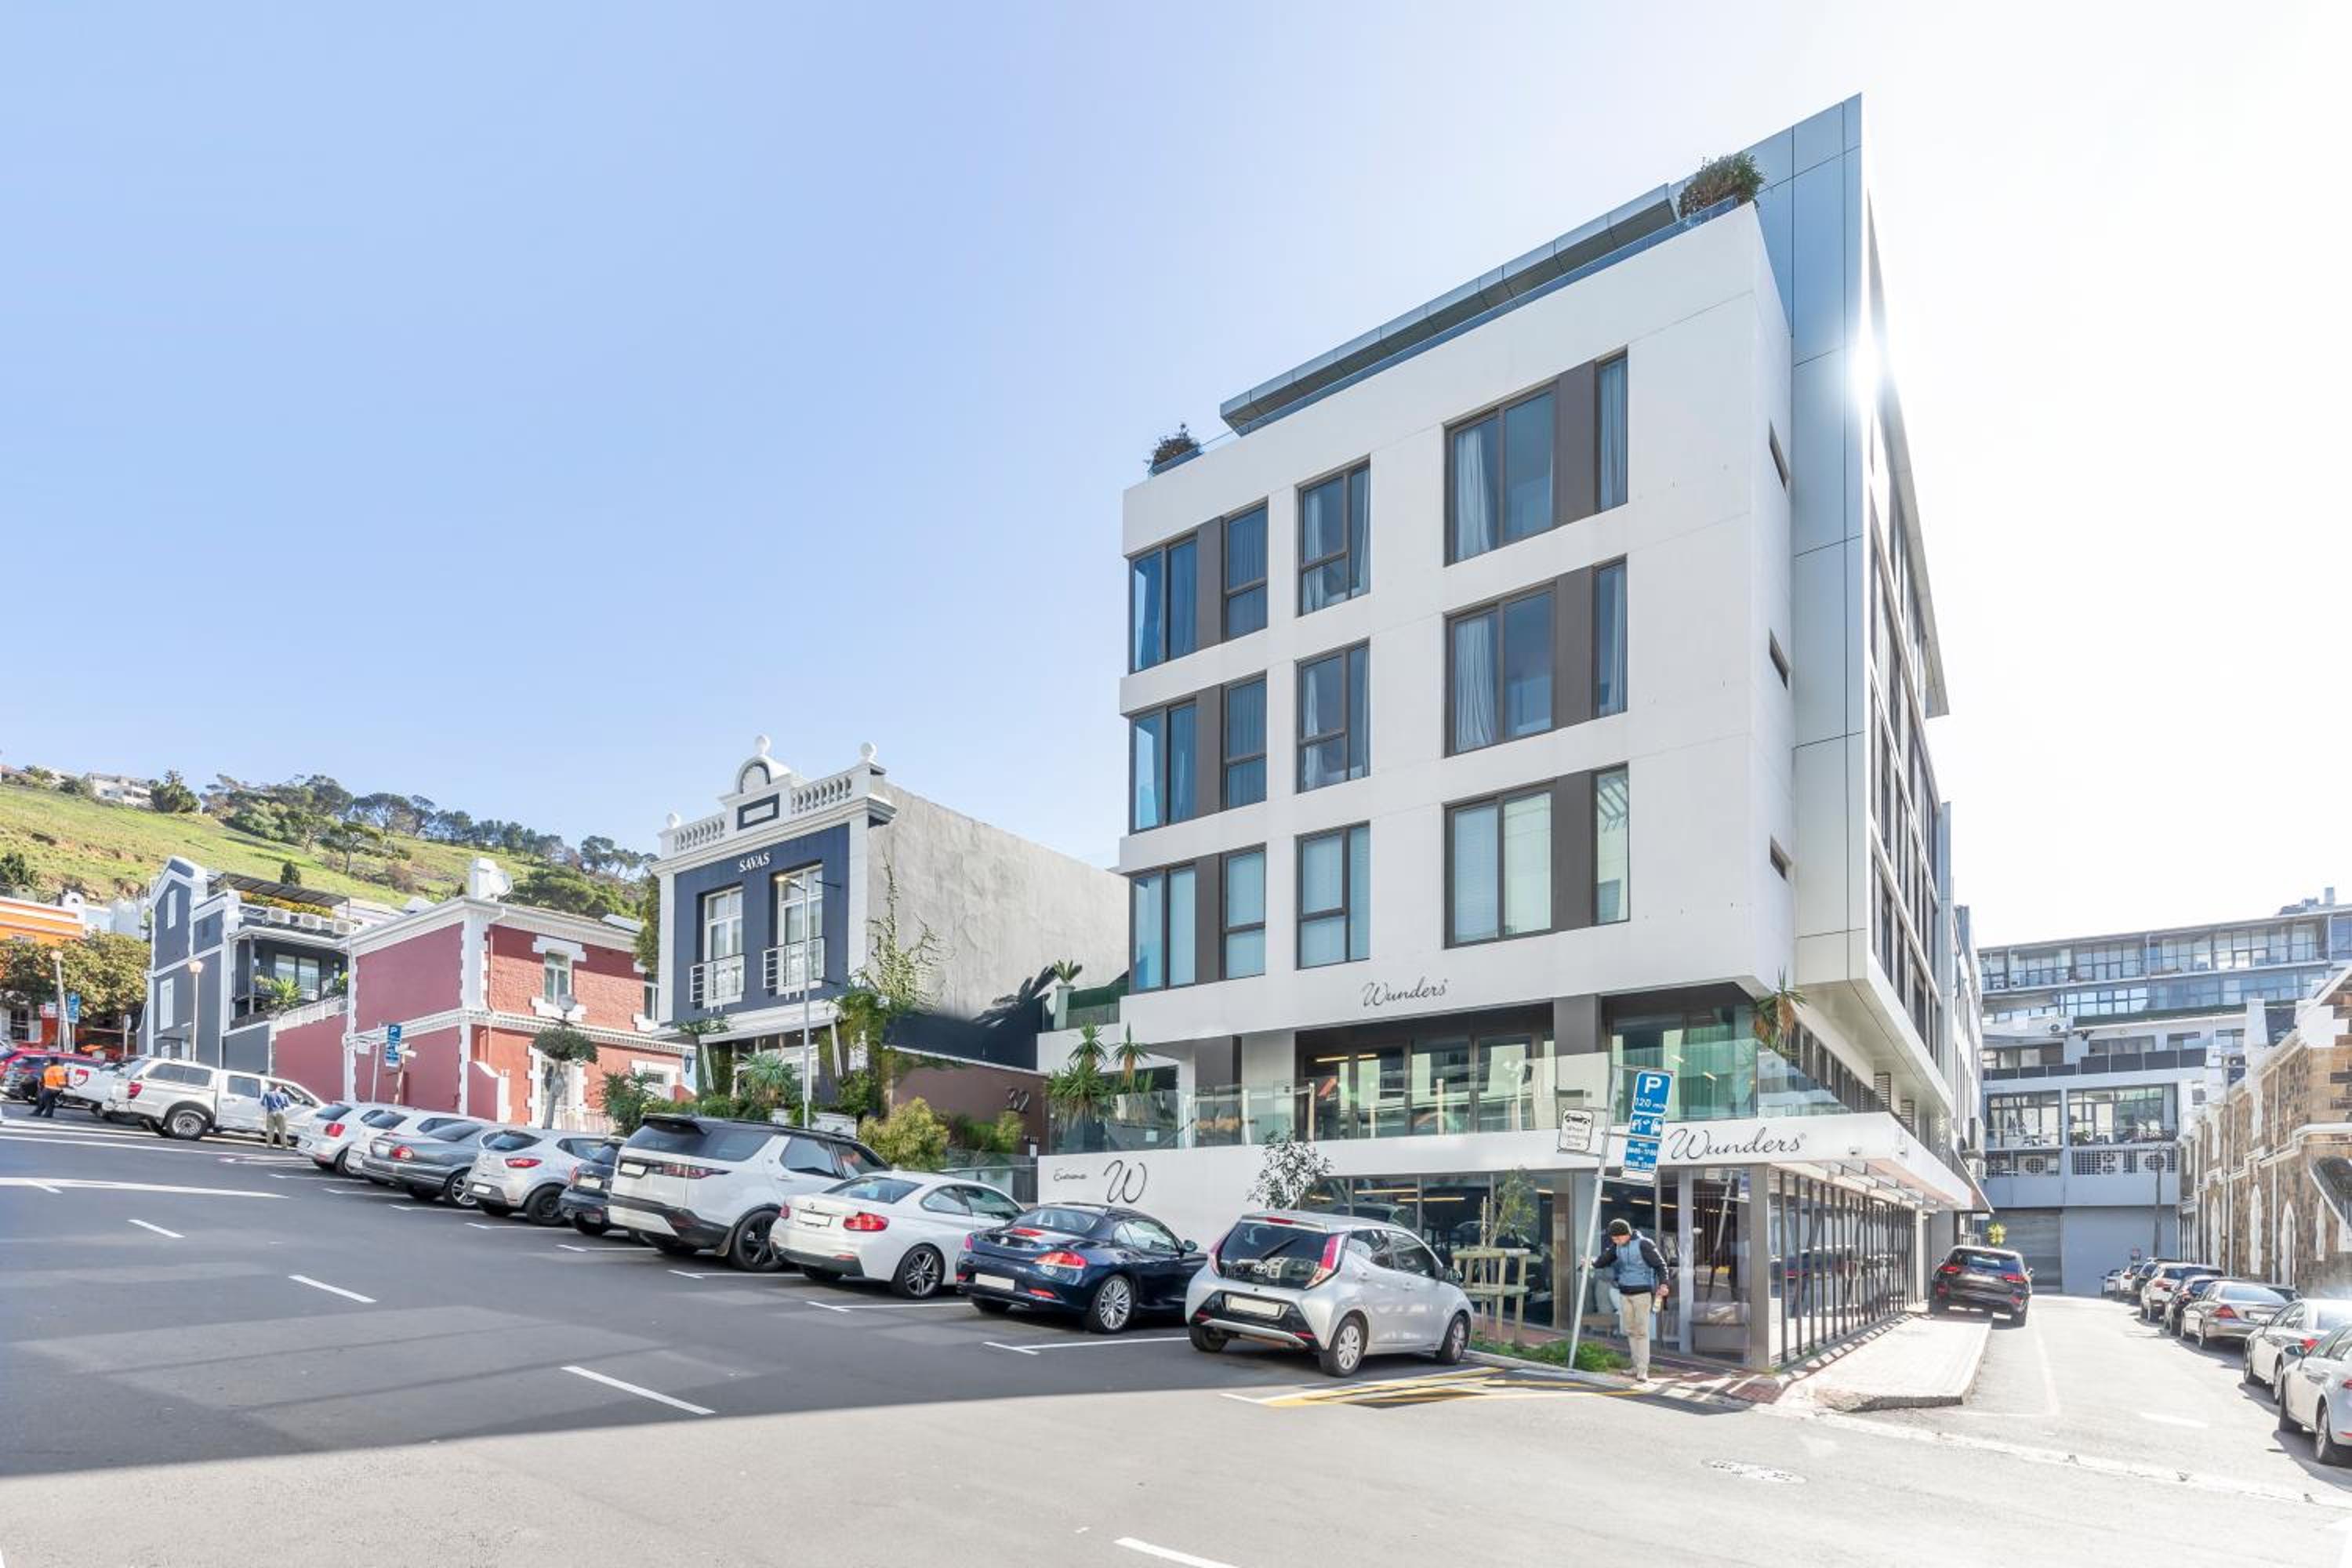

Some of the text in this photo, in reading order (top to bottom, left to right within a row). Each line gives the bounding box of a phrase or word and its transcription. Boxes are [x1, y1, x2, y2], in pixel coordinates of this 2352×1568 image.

[739, 852, 771, 873] SAVAS
[1644, 1076, 1663, 1094] P
[1103, 1160, 1147, 1203] W
